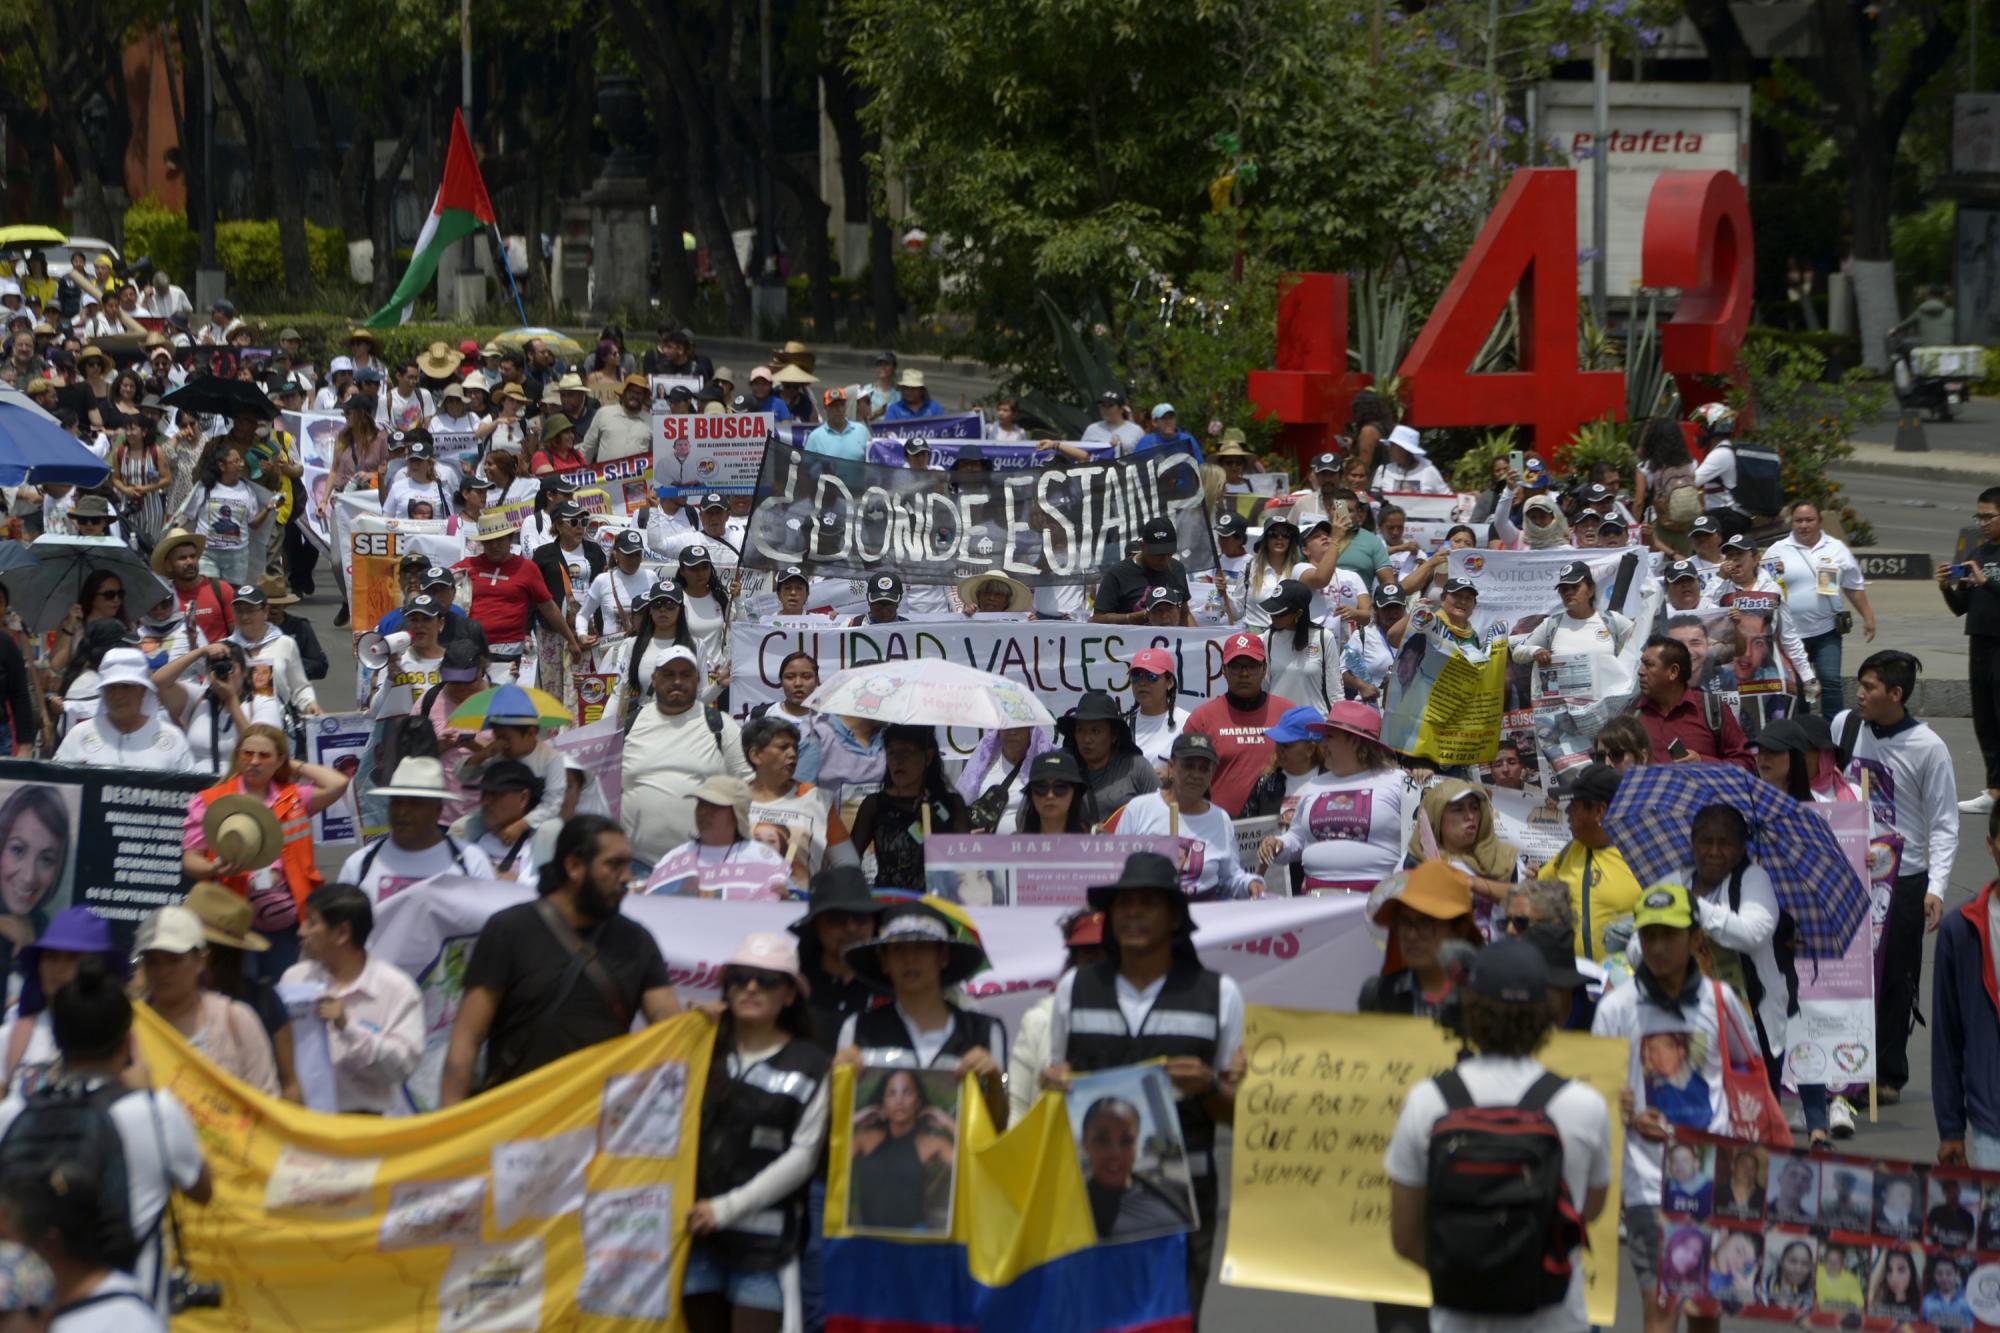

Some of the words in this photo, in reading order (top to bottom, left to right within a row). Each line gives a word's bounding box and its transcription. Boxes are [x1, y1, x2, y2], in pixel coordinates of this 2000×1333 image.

[1573, 129, 1703, 154] etafeta
[664, 417, 688, 440] SE
[694, 415, 766, 439] BUSCA
[928, 449, 957, 469] Dio
[354, 533, 388, 556] SE
[963, 636, 1131, 692] VALLES
[101, 784, 190, 808] DESAPAREC
[1012, 841, 1052, 853] HAS
[1307, 1129, 1338, 1154] NO
[1350, 1133, 1393, 1155] IMPO
[1244, 1157, 1322, 1189] SIEMPRE
